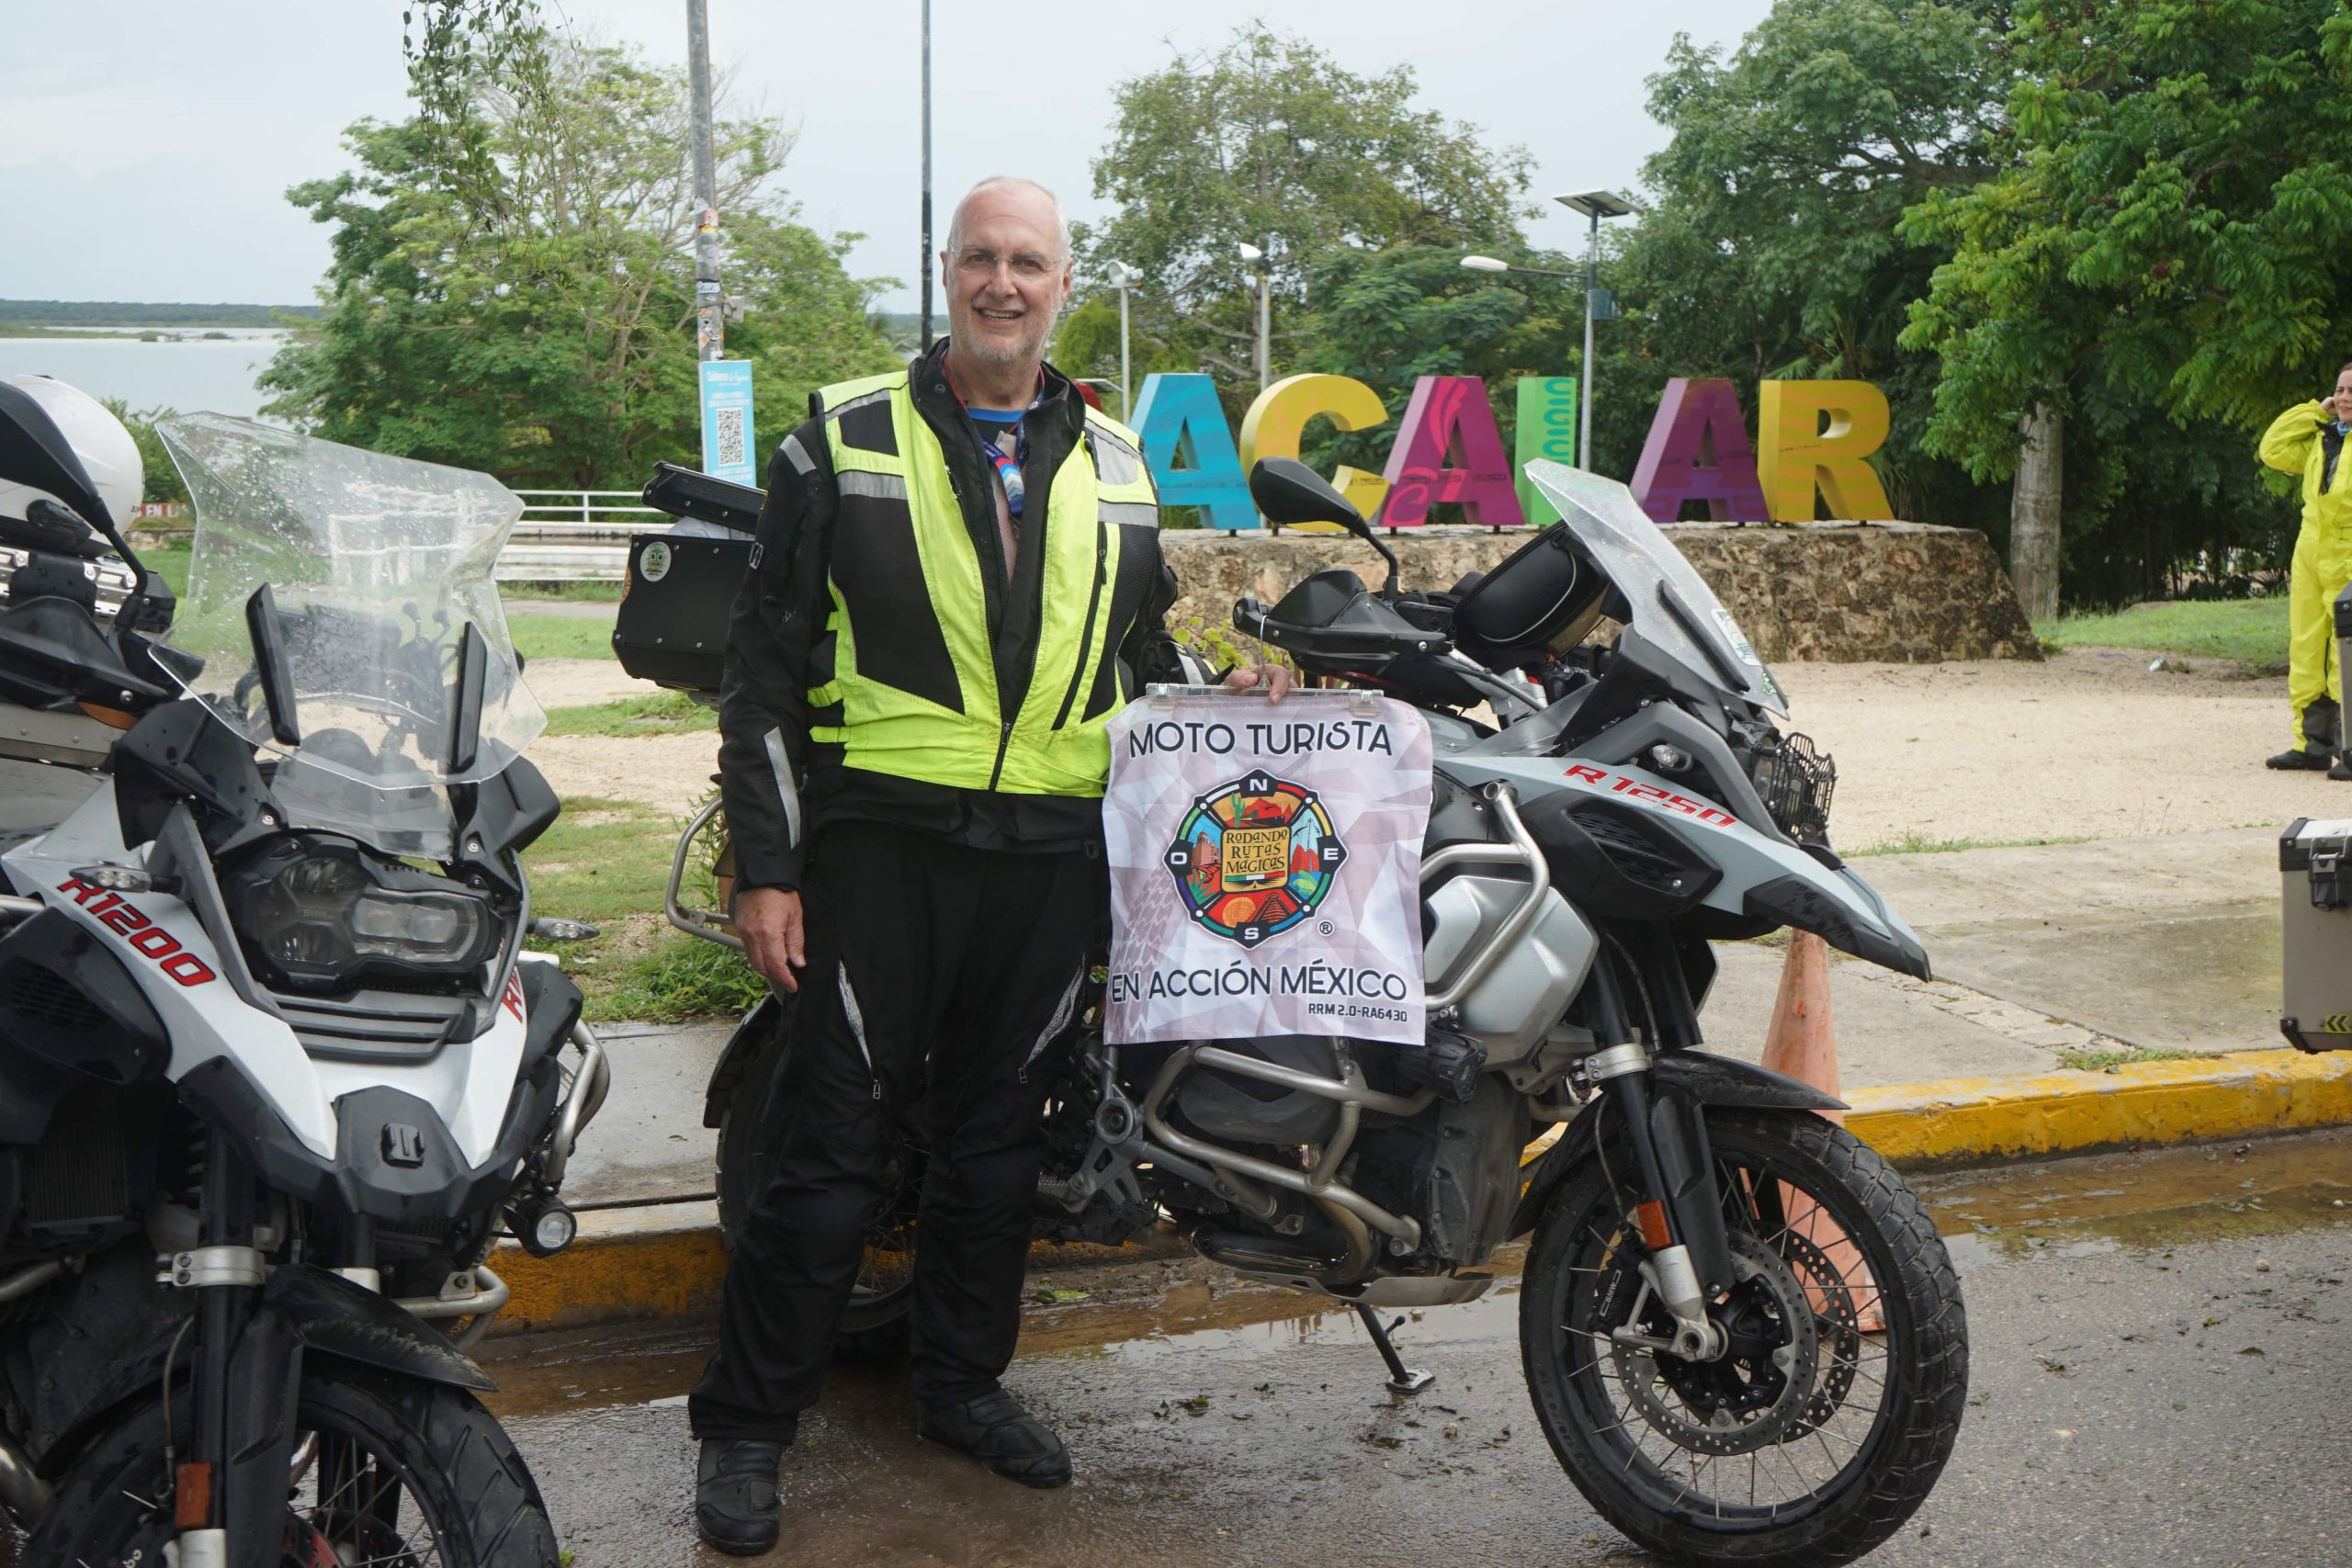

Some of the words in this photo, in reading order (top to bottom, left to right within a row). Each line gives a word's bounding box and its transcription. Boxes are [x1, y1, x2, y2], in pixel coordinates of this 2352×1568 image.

[1074, 372, 1894, 533] ACALAR
[1129, 721, 1236, 758] MOTO
[1247, 720, 1393, 756] TURISTA
[1250, 778, 1268, 791] N
[1323, 847, 1339, 861] E
[57, 878, 216, 987] R1200
[1244, 927, 1260, 940] S
[1112, 971, 1140, 1002] EN
[1148, 959, 1272, 998] ACCIÓN
[1281, 958, 1408, 1001] MÉXICO
[1308, 1003, 1336, 1015] RRM
